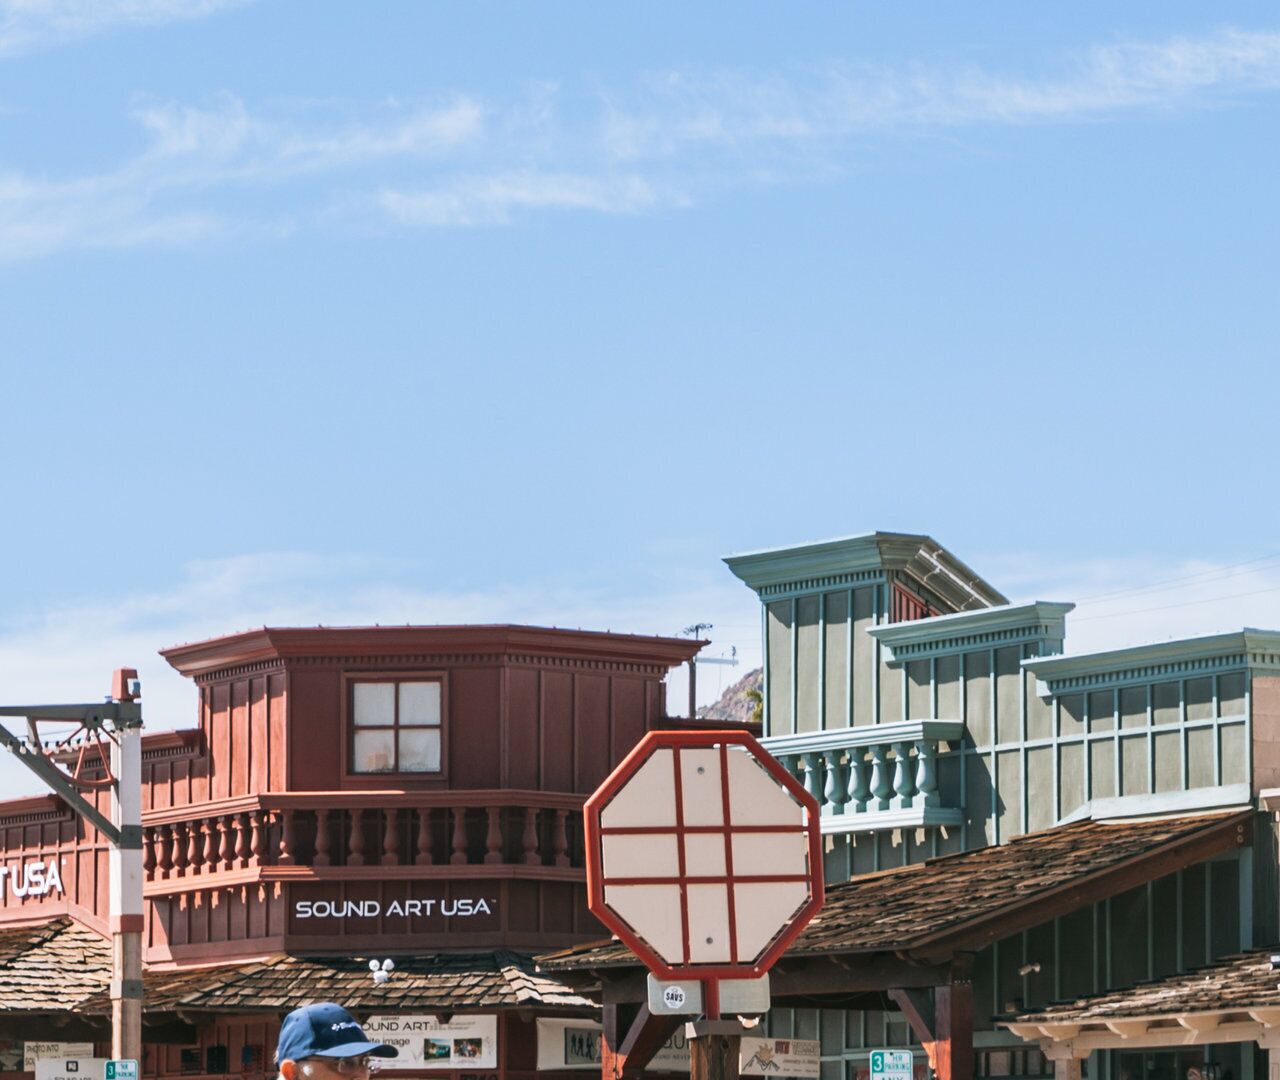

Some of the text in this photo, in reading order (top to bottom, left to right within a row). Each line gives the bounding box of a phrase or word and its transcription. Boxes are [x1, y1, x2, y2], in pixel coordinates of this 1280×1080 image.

[11, 859, 63, 898] USA
[295, 898, 491, 918] SOUND ART USA
[665, 992, 684, 1002] SAVS
[362, 1021, 399, 1031] OUND
[402, 1021, 431, 1031] ART
[382, 1037, 410, 1048] image
[873, 1055, 882, 1072] 3
[884, 1062, 910, 1071] PARKING
[108, 1065, 114, 1076] 3
